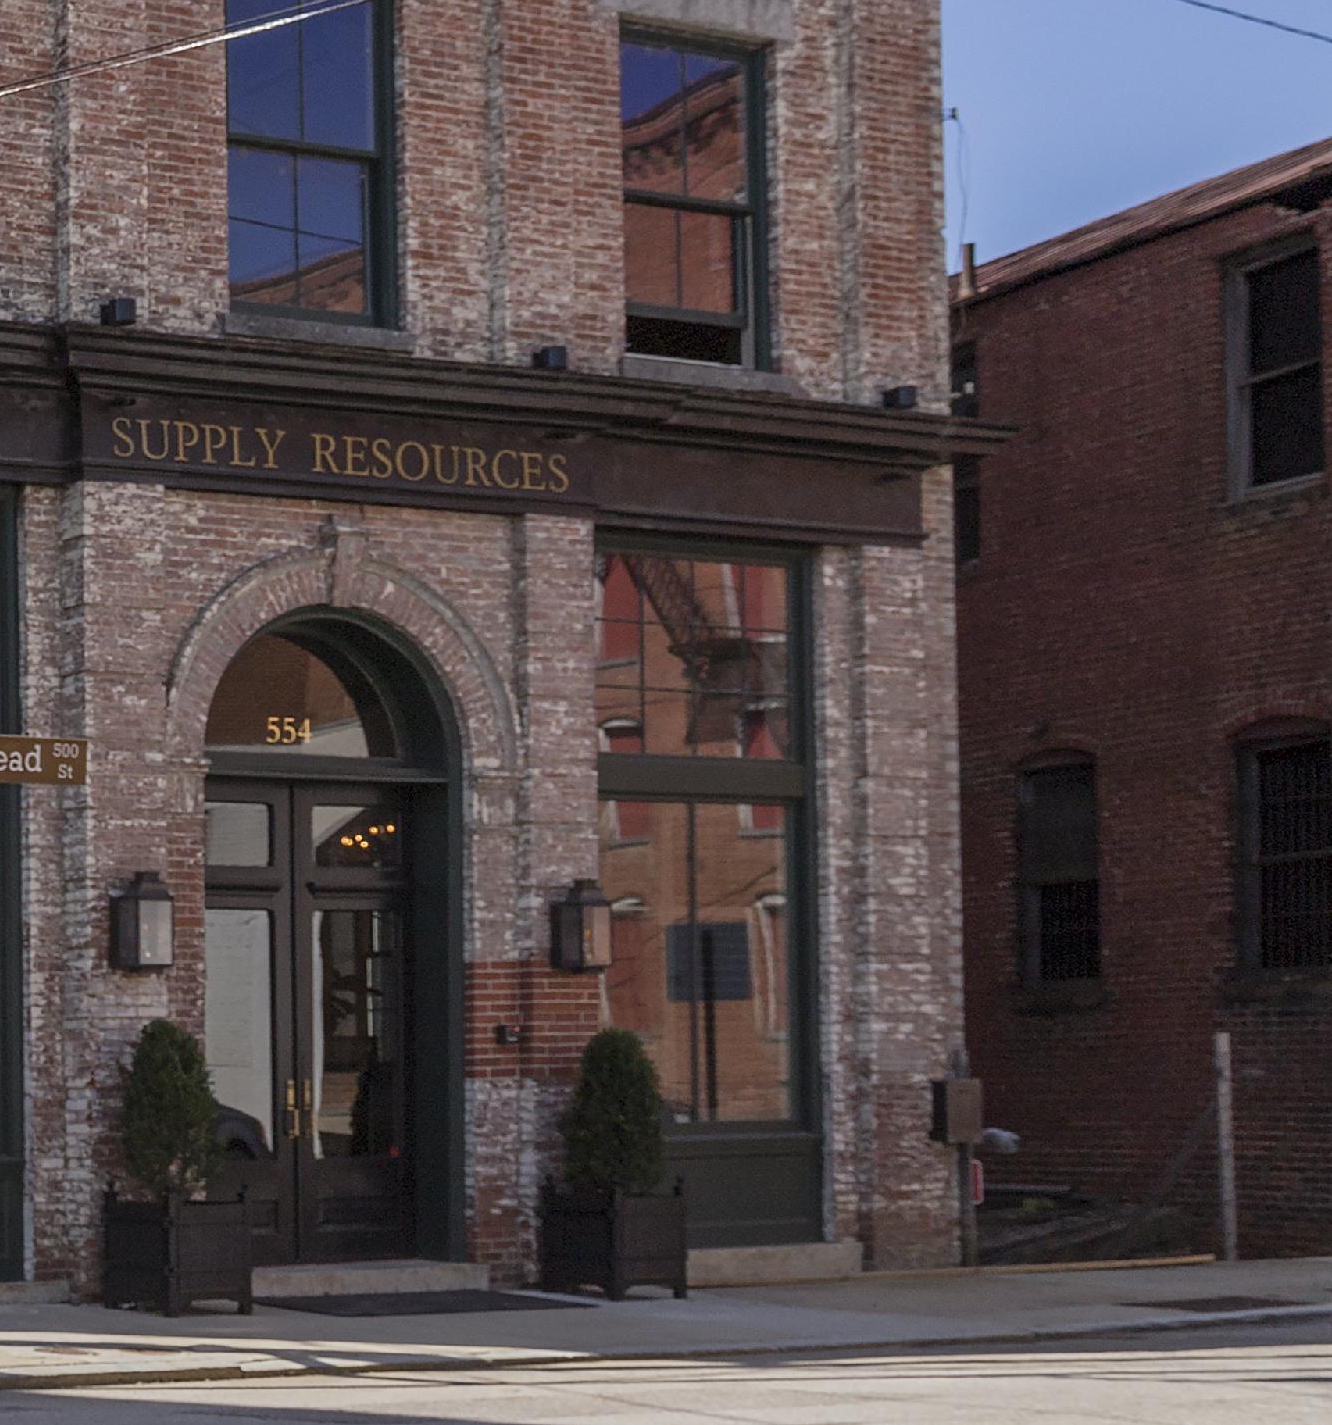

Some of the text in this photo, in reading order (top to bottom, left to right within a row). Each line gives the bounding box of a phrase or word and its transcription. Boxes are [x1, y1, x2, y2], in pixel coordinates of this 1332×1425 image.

[110, 416, 570, 494] SUPPLY RESOURCES
[265, 716, 313, 745] 554
[52, 742, 80, 759] 500
[57, 763, 74, 780] St
